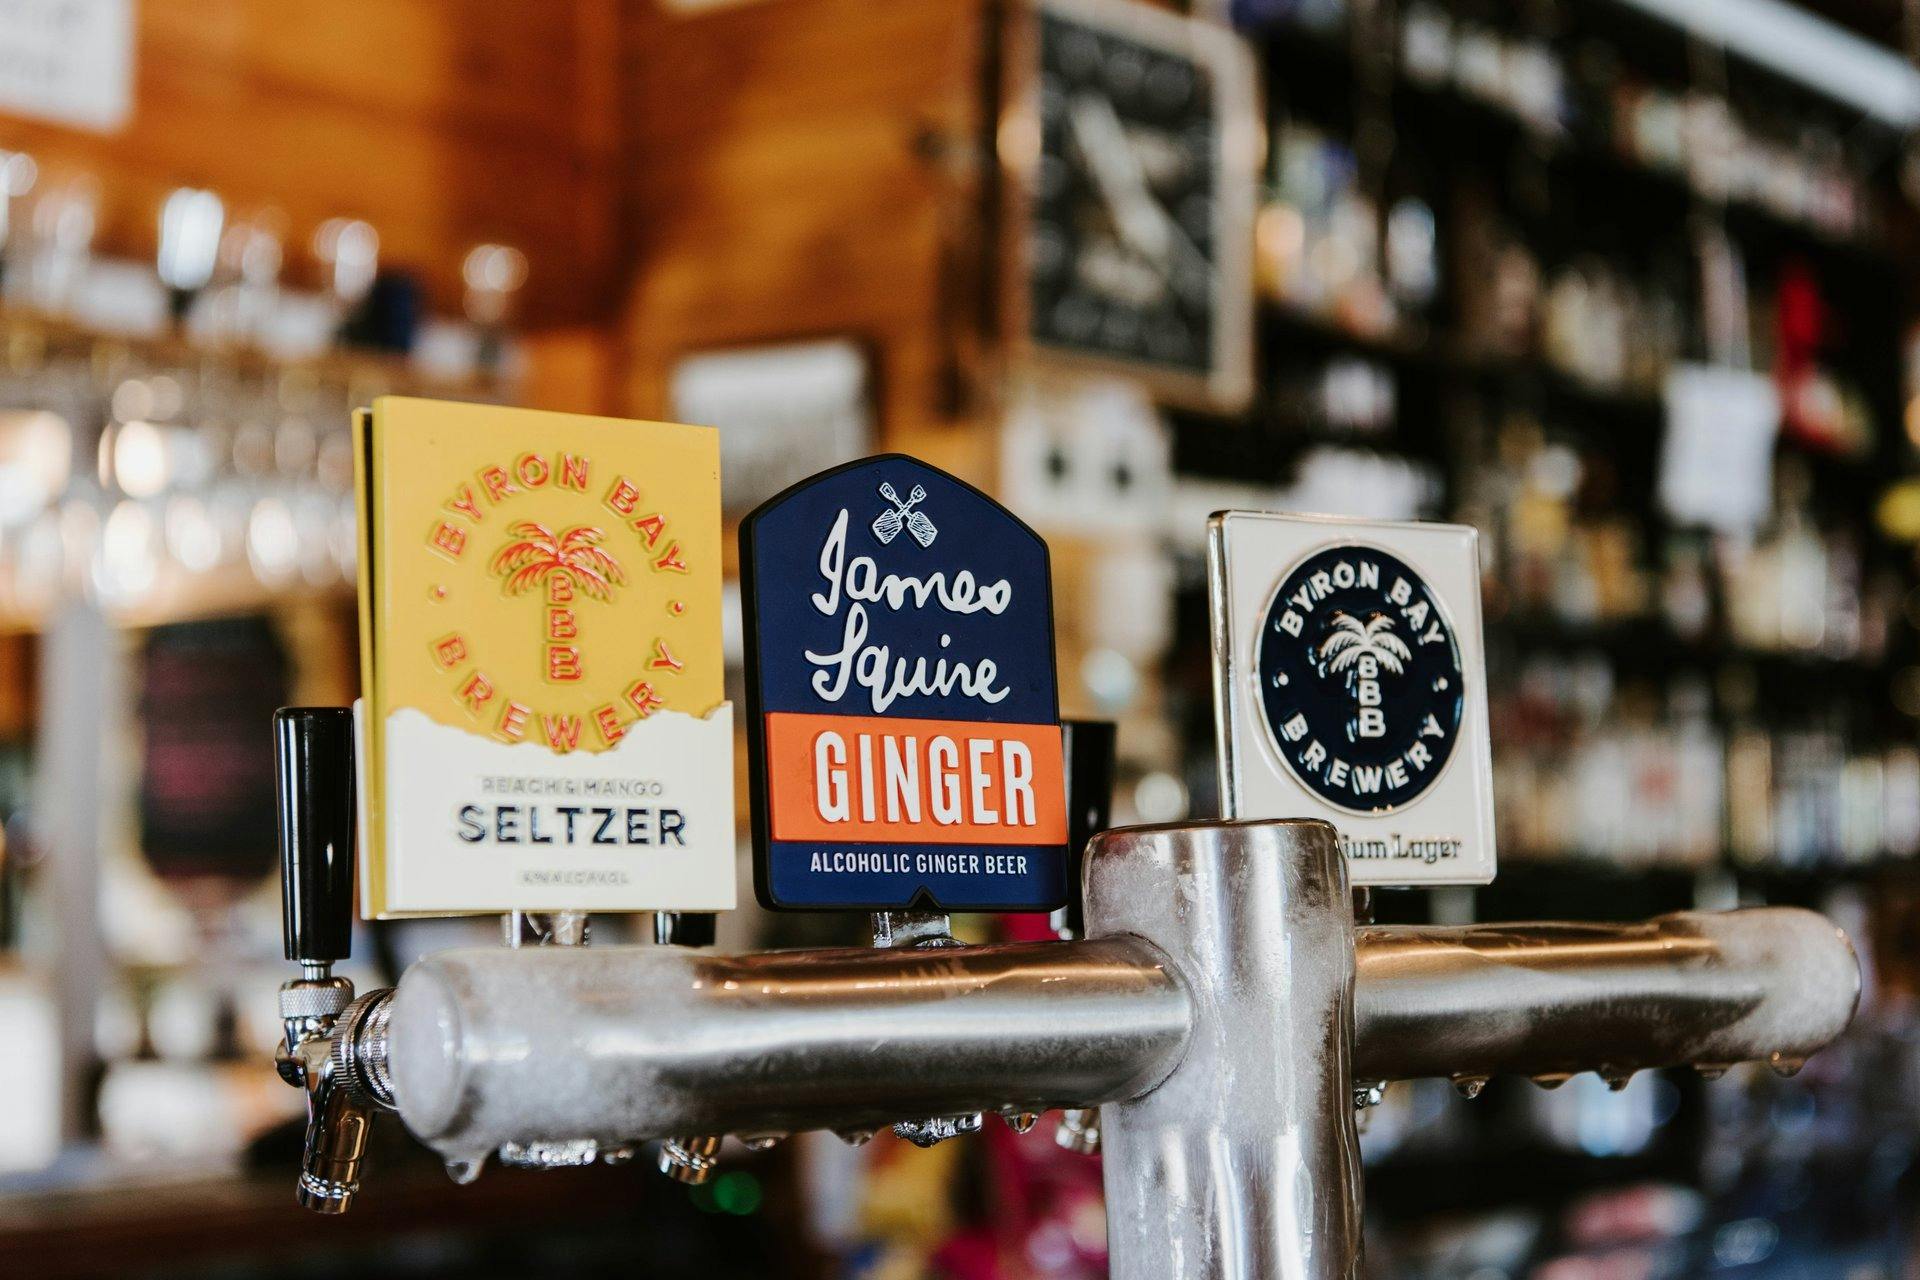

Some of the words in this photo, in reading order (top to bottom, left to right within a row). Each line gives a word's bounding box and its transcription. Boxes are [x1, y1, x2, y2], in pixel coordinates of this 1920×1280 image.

[434, 453, 590, 556] BYRON
[611, 479, 687, 574] BAY
[812, 508, 1012, 616] James
[1278, 561, 1380, 638] BYRON
[1390, 577, 1445, 645] BAY
[437, 635, 684, 751] BREWERY
[804, 602, 1011, 713] Squire
[584, 778, 664, 797] MANGO
[814, 730, 1038, 826] GINGER
[1283, 712, 1446, 794] BREWERY
[458, 804, 687, 847] SELTZER
[810, 852, 910, 873] ALCOHOLIC
[916, 854, 979, 874] GINGER
[985, 855, 1028, 875] BEER
